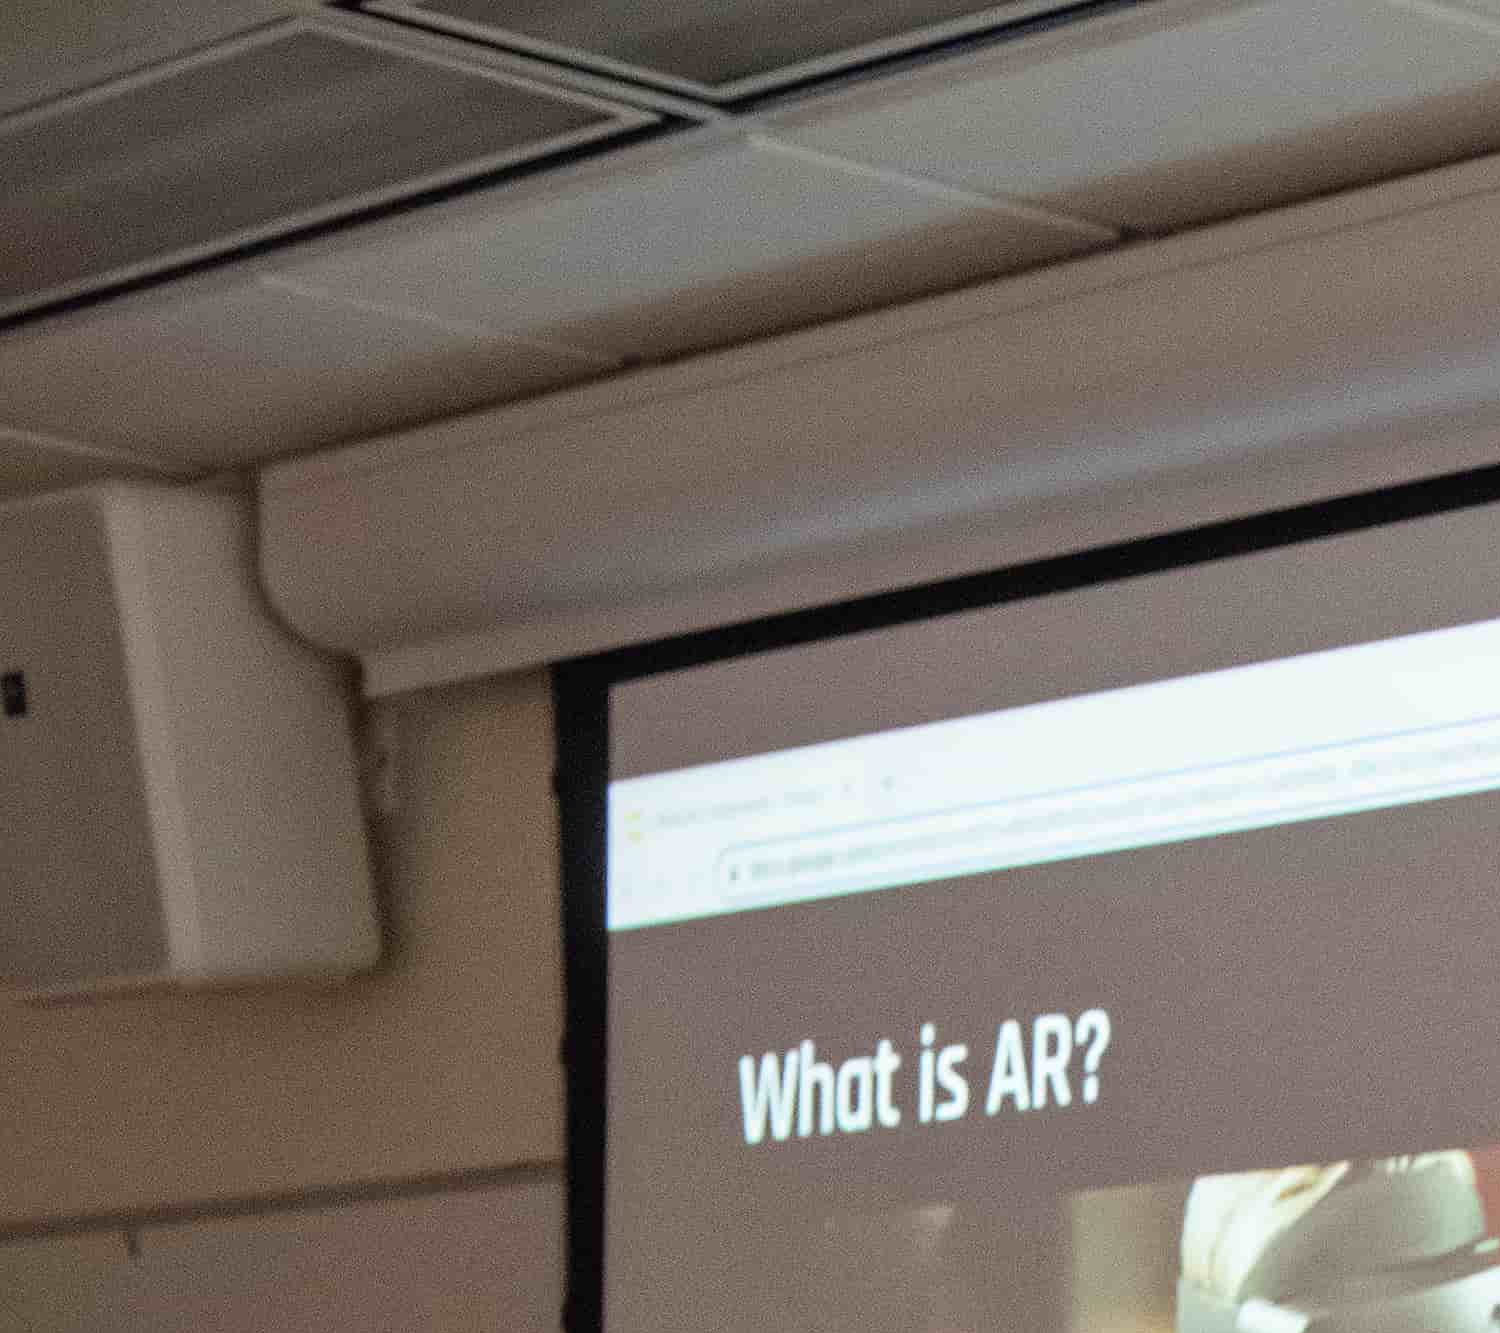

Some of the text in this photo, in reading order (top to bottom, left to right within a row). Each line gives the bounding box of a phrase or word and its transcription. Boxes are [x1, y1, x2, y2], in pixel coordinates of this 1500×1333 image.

[739, 1008, 1110, 1145] What is AR?
